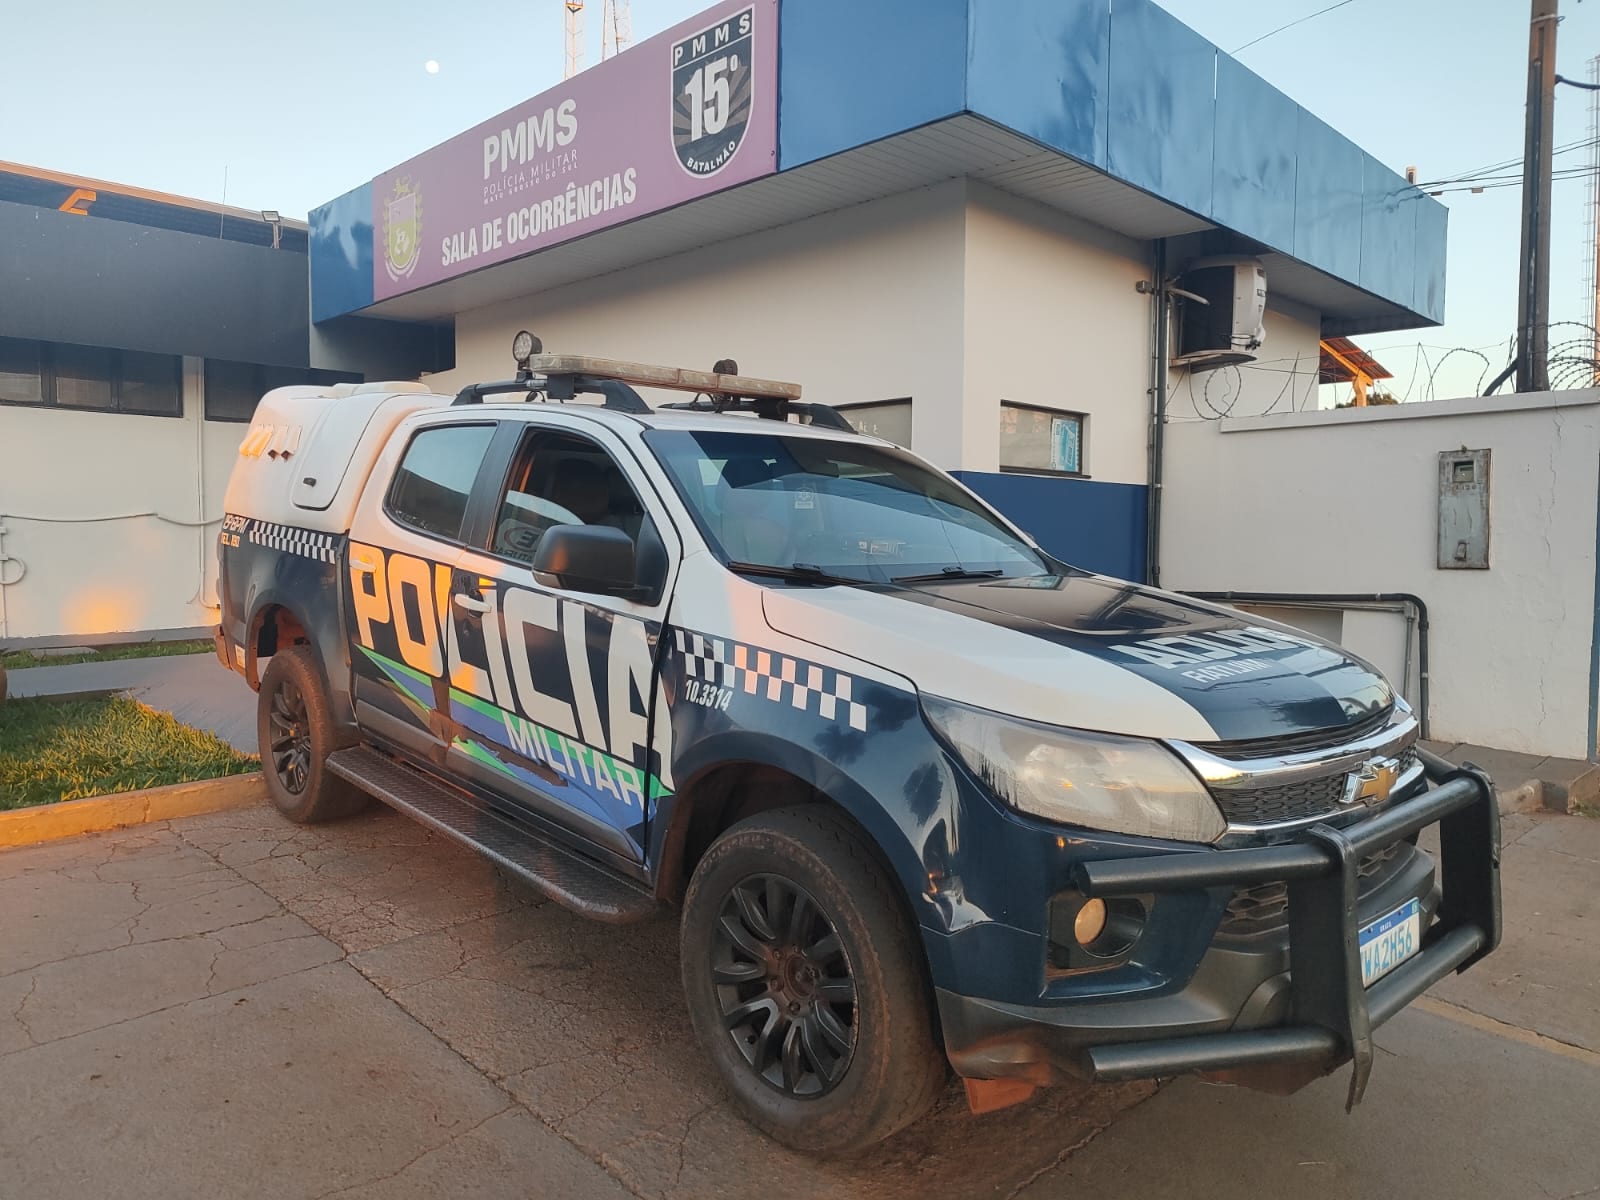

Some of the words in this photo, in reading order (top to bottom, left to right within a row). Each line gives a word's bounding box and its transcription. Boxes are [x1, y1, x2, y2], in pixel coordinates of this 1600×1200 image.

[674, 13, 750, 66] PMMS
[483, 98, 578, 180] PMMS
[530, 148, 577, 178] MILITAR
[686, 140, 736, 172] BATALHÃO
[441, 227, 479, 266] SALA
[482, 217, 503, 253] DE
[507, 167, 637, 244] OCORRÊNCIAS
[685, 679, 734, 712] 10.3314
[501, 710, 650, 816] MILITAR
[1360, 920, 1412, 980] WA2H56
